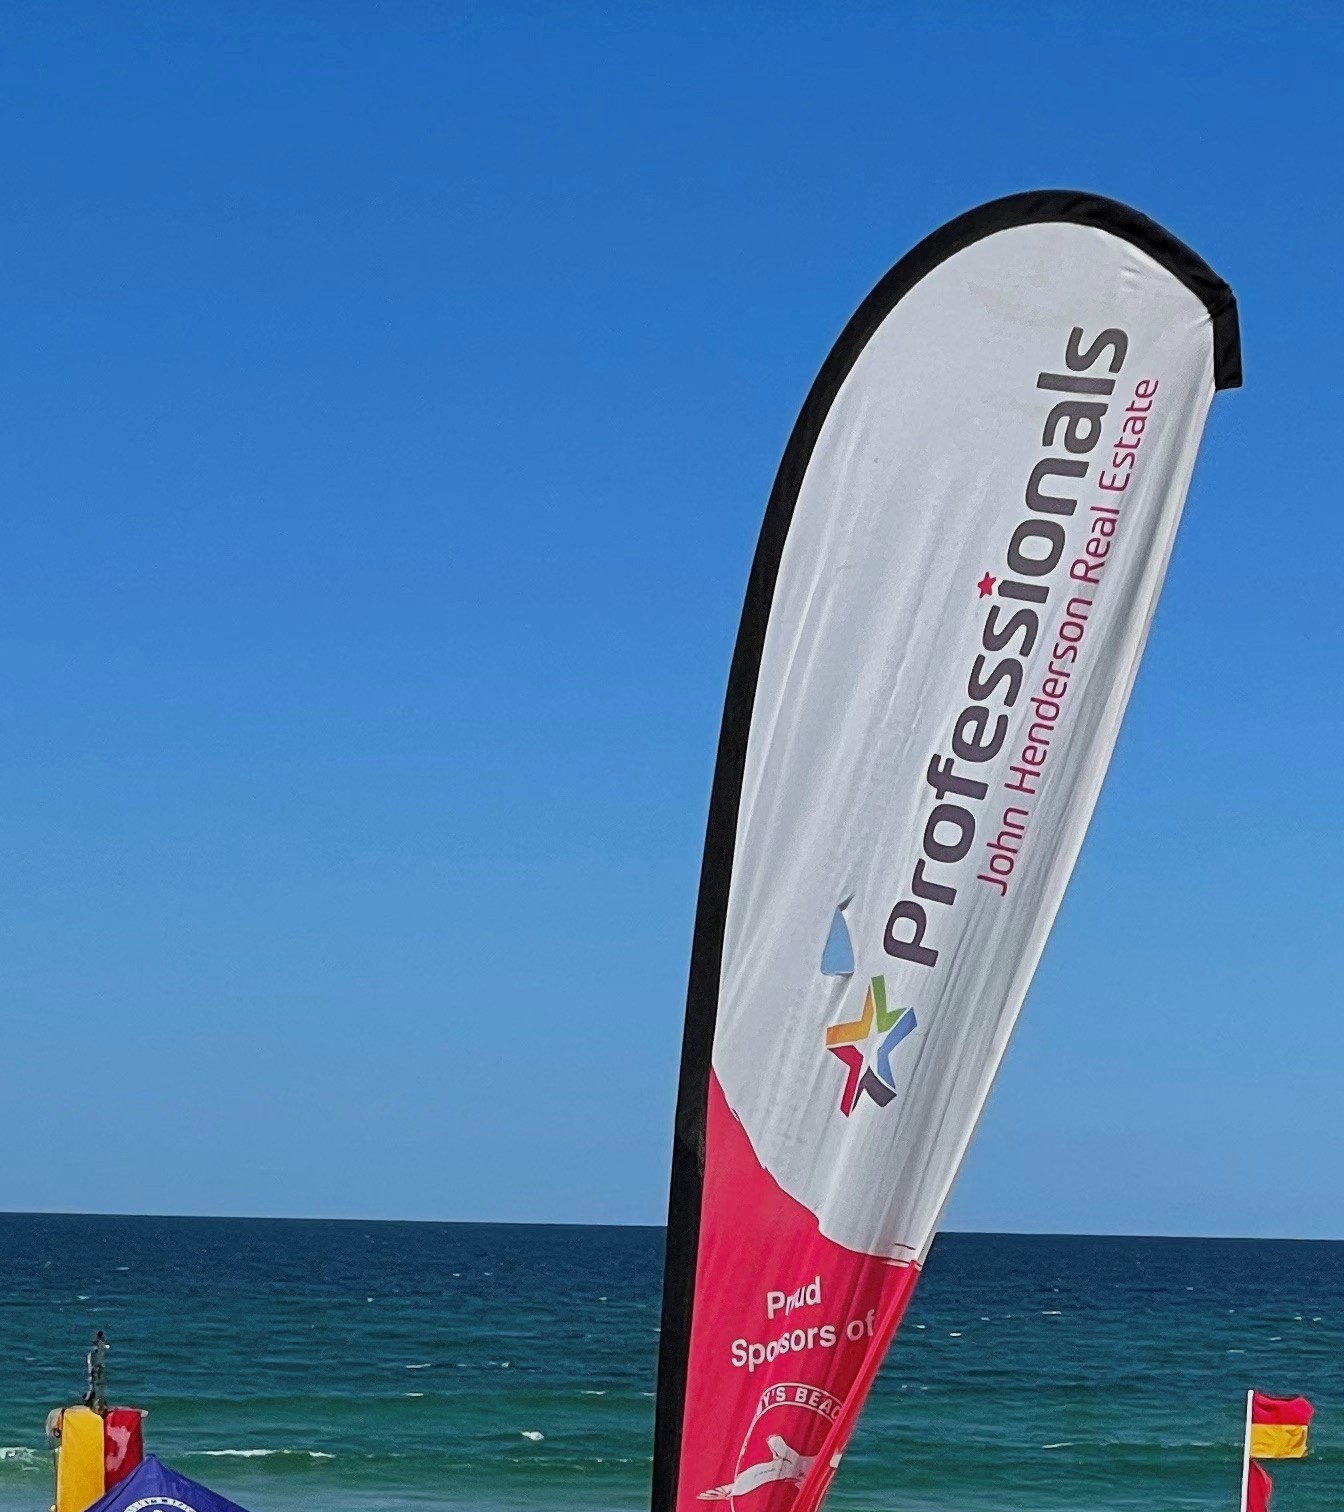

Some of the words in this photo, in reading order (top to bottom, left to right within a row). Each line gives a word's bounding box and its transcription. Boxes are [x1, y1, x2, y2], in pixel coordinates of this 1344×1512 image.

[883, 325, 1129, 968] Professionals
[976, 806, 1029, 897] John
[1004, 596, 1095, 795] Henderson
[1069, 505, 1121, 585] Real
[1098, 378, 1159, 492] Estate
[846, 1308, 876, 1342] of
